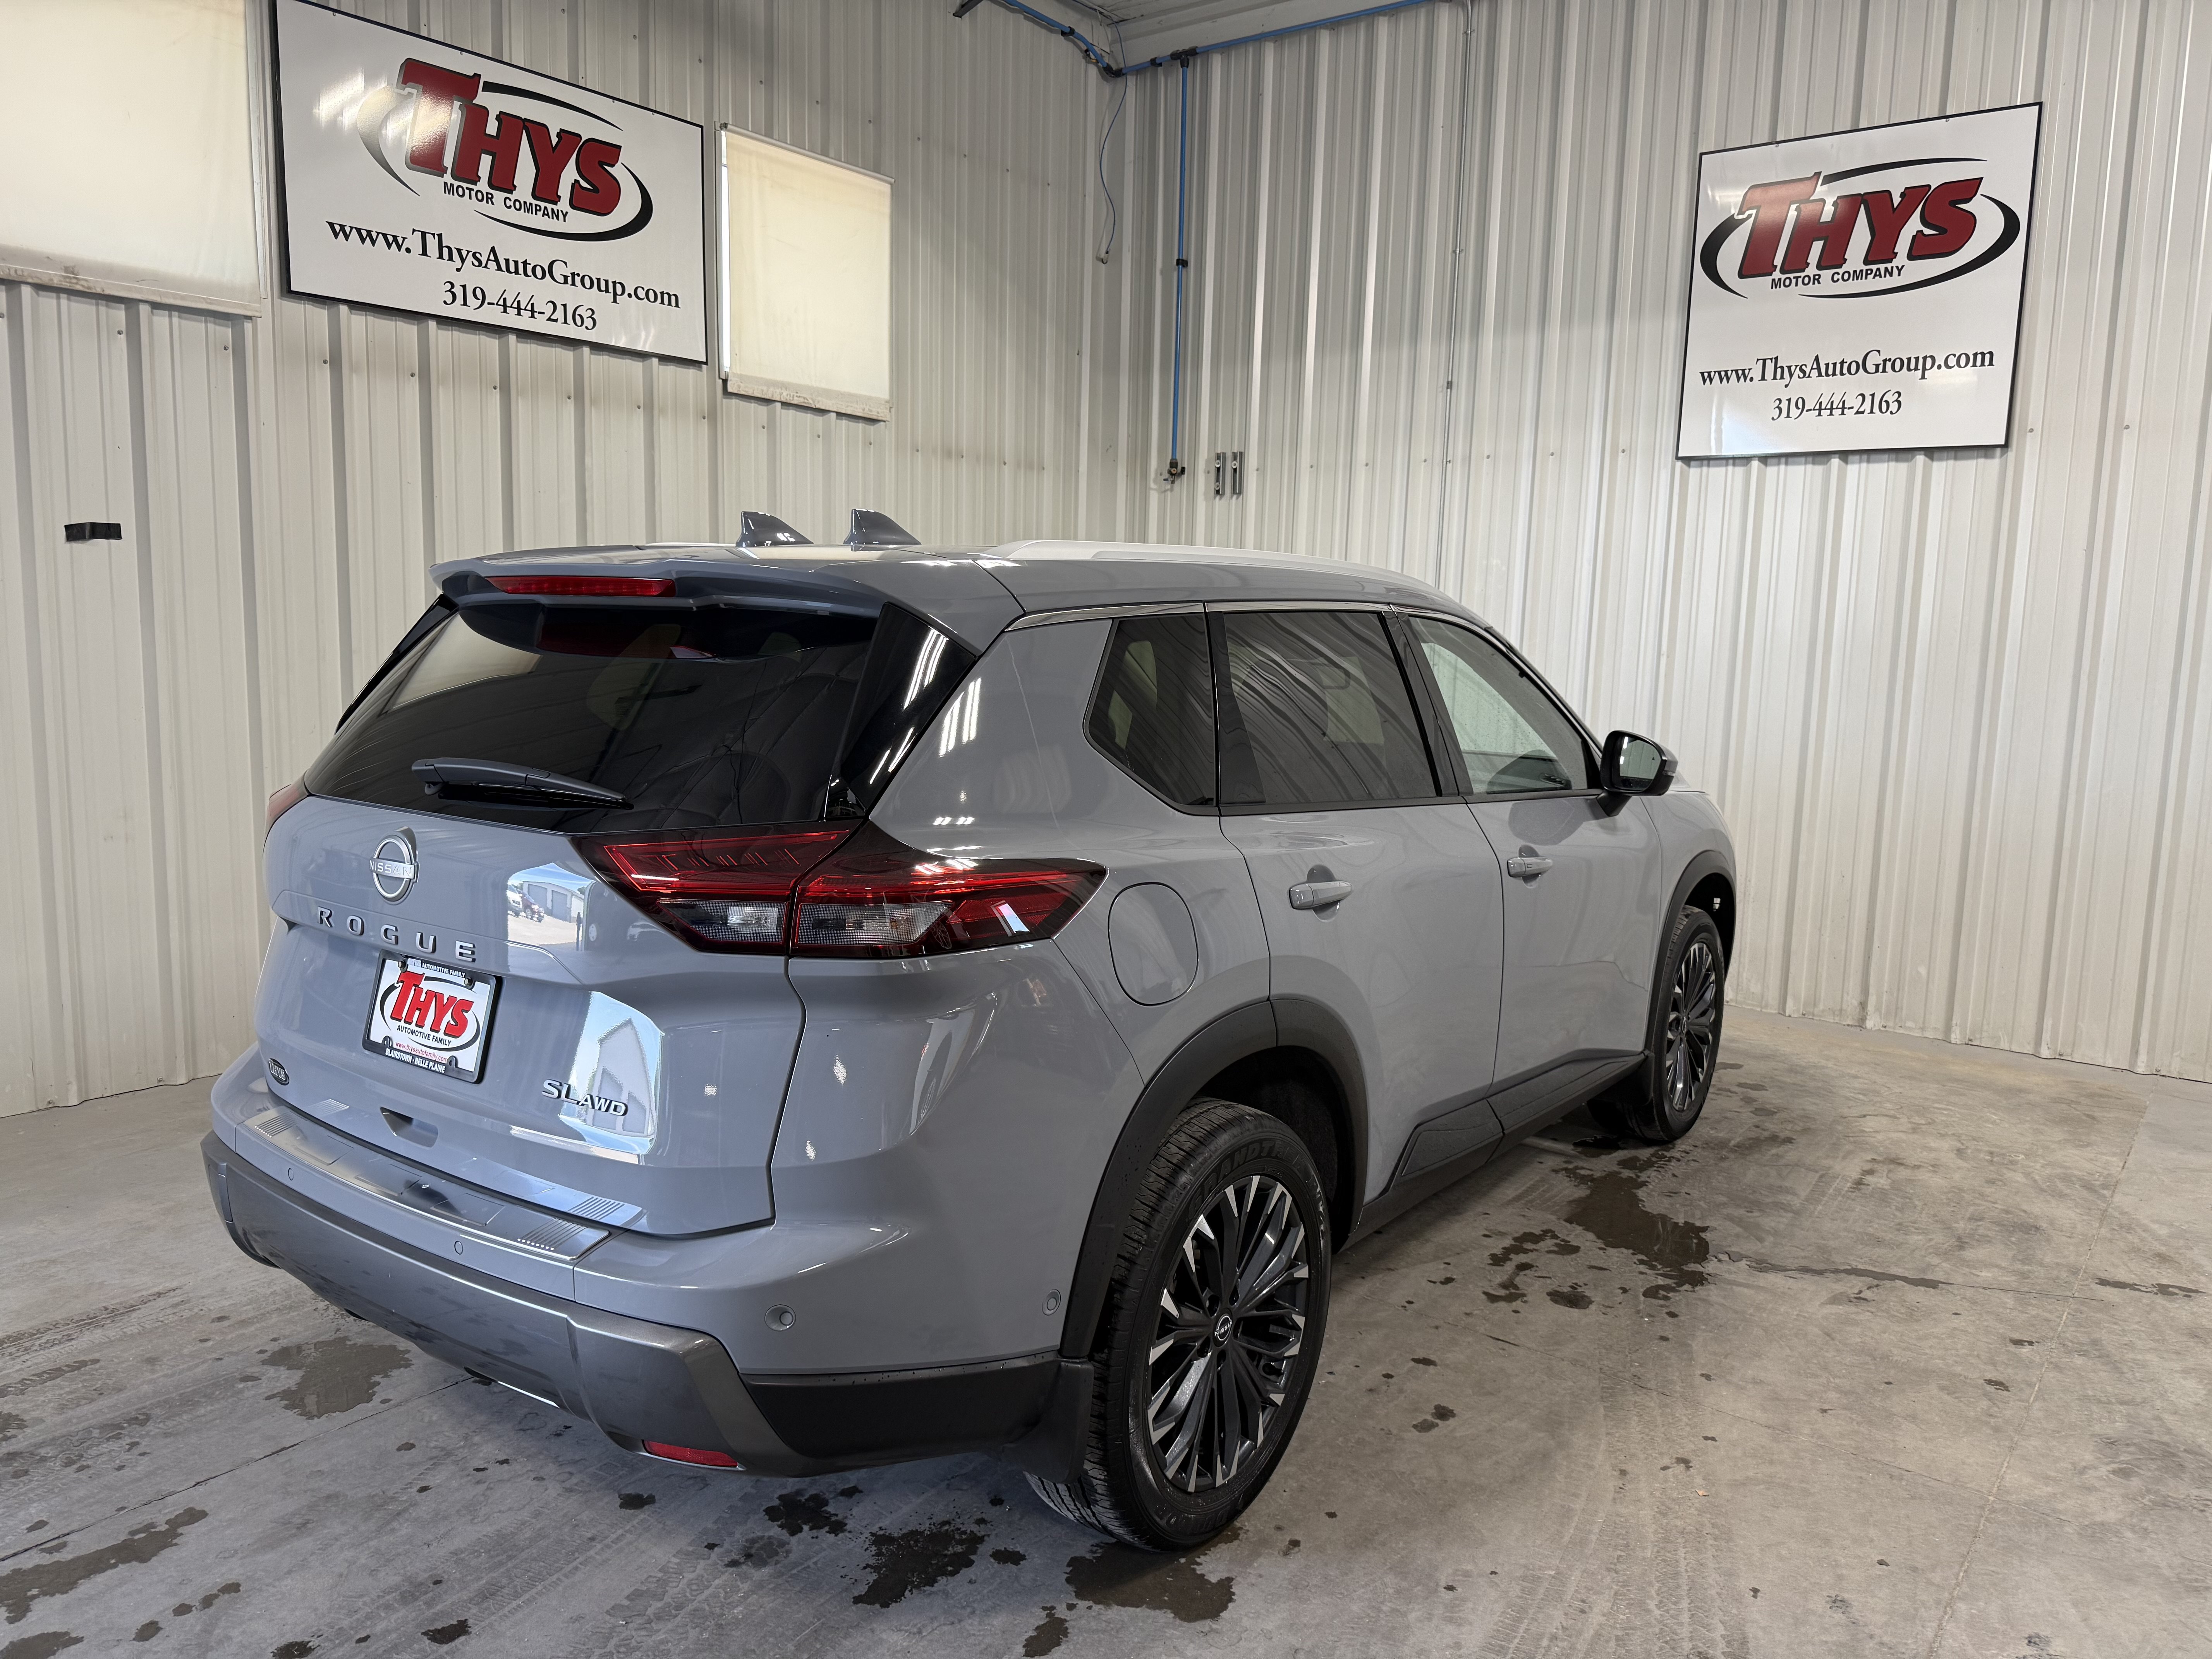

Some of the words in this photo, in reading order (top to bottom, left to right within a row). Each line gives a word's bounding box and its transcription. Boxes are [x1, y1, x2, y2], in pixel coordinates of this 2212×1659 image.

[396, 57, 622, 216] THYS
[443, 182, 495, 206] MOTOR
[503, 196, 568, 223] COMPANY
[1736, 171, 1984, 279] THYS
[326, 221, 680, 309] www.ThysAutoGroup.com
[1771, 274, 1822, 289] MOTOR
[1831, 265, 1905, 283] COMPANY
[443, 281, 598, 331] 319-444-2163
[1699, 349, 1995, 388] www.ThysAutoGroup.com
[1771, 390, 1903, 421] 319-444-2163
[369, 860, 412, 877] NISSAN
[317, 906, 476, 963] ROGUE
[422, 963, 449, 974] AUTOMOTIVE
[450, 970, 465, 978] FAMILY
[397, 1025, 431, 1041] AUTOMOTIVE
[432, 1035, 452, 1046] FAMILY
[385, 1048, 412, 1063] BLAIRSTOWN
[414, 1057, 429, 1068] BELLE
[429, 1061, 446, 1073] PLAINE
[1214, 1319, 1232, 1336] NISSAN
